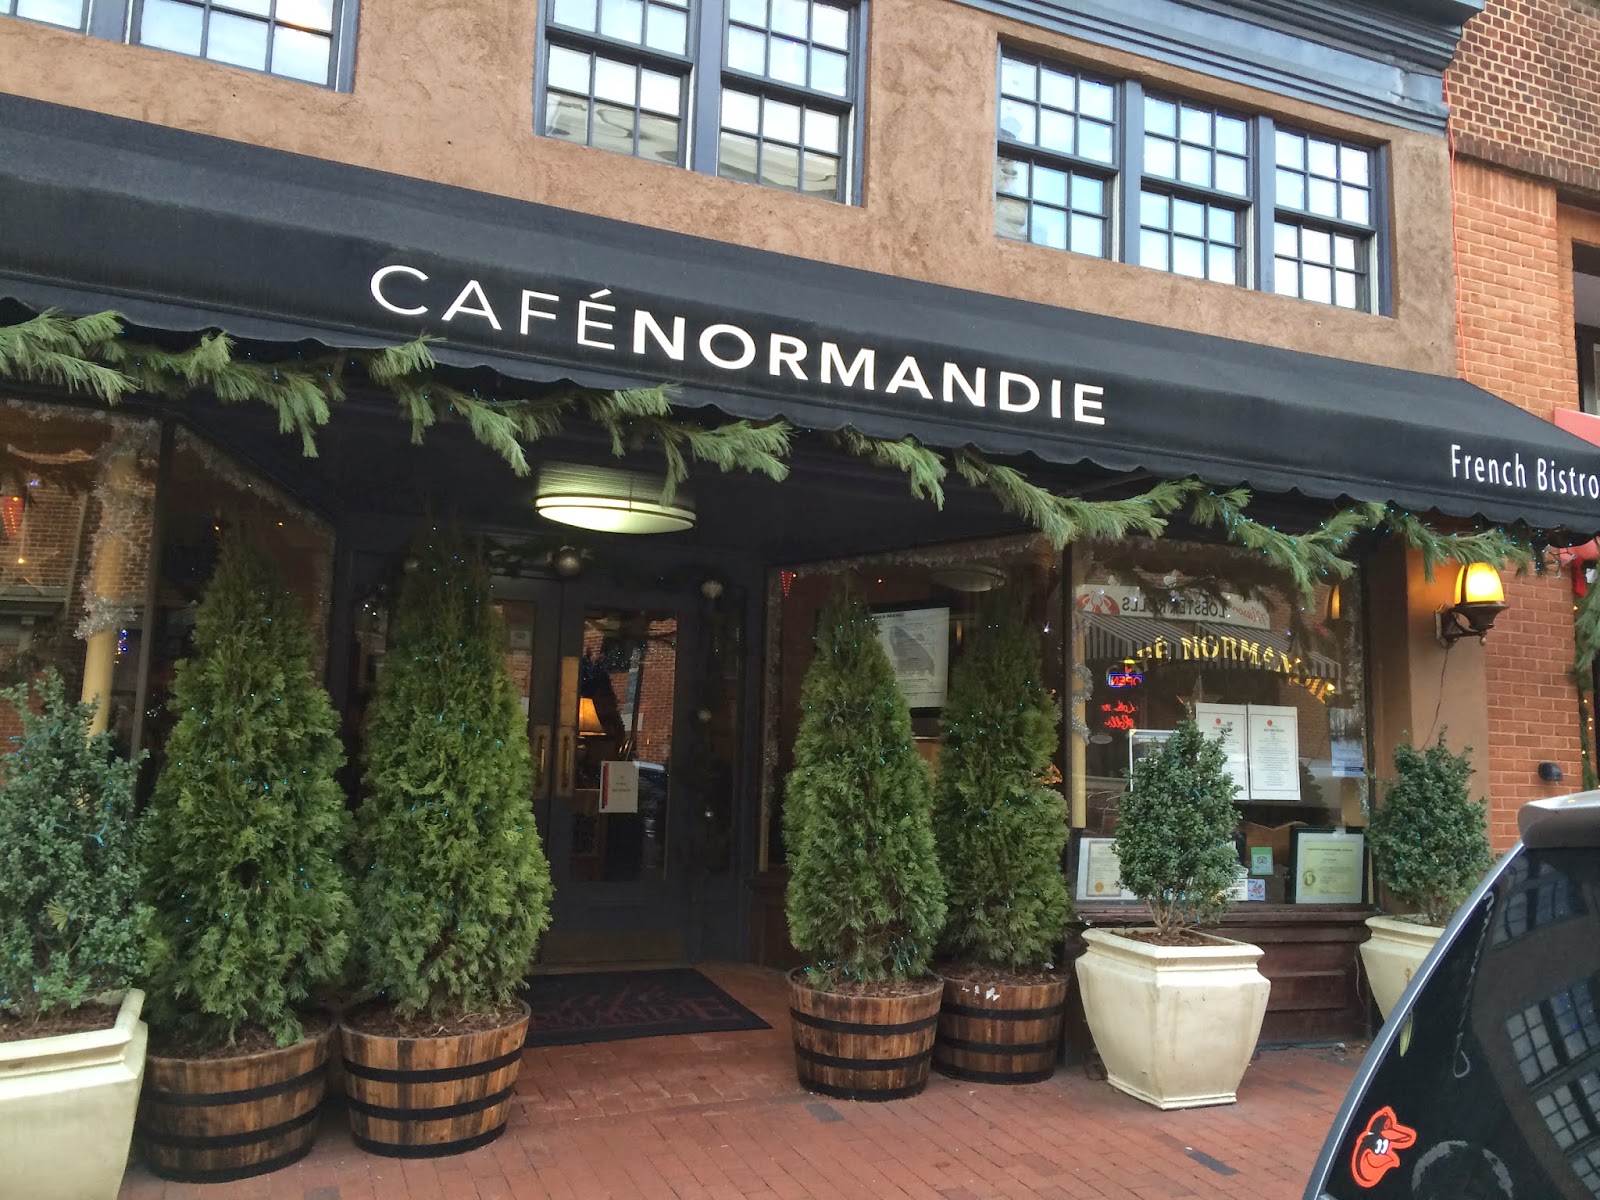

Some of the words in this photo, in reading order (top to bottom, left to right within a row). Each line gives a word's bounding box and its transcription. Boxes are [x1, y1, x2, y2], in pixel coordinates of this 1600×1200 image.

[370, 264, 616, 351] CAFÉ
[632, 309, 1106, 426] NORMANDIE
[1451, 443, 1527, 488] French
[1537, 457, 1600, 499] Bistro
